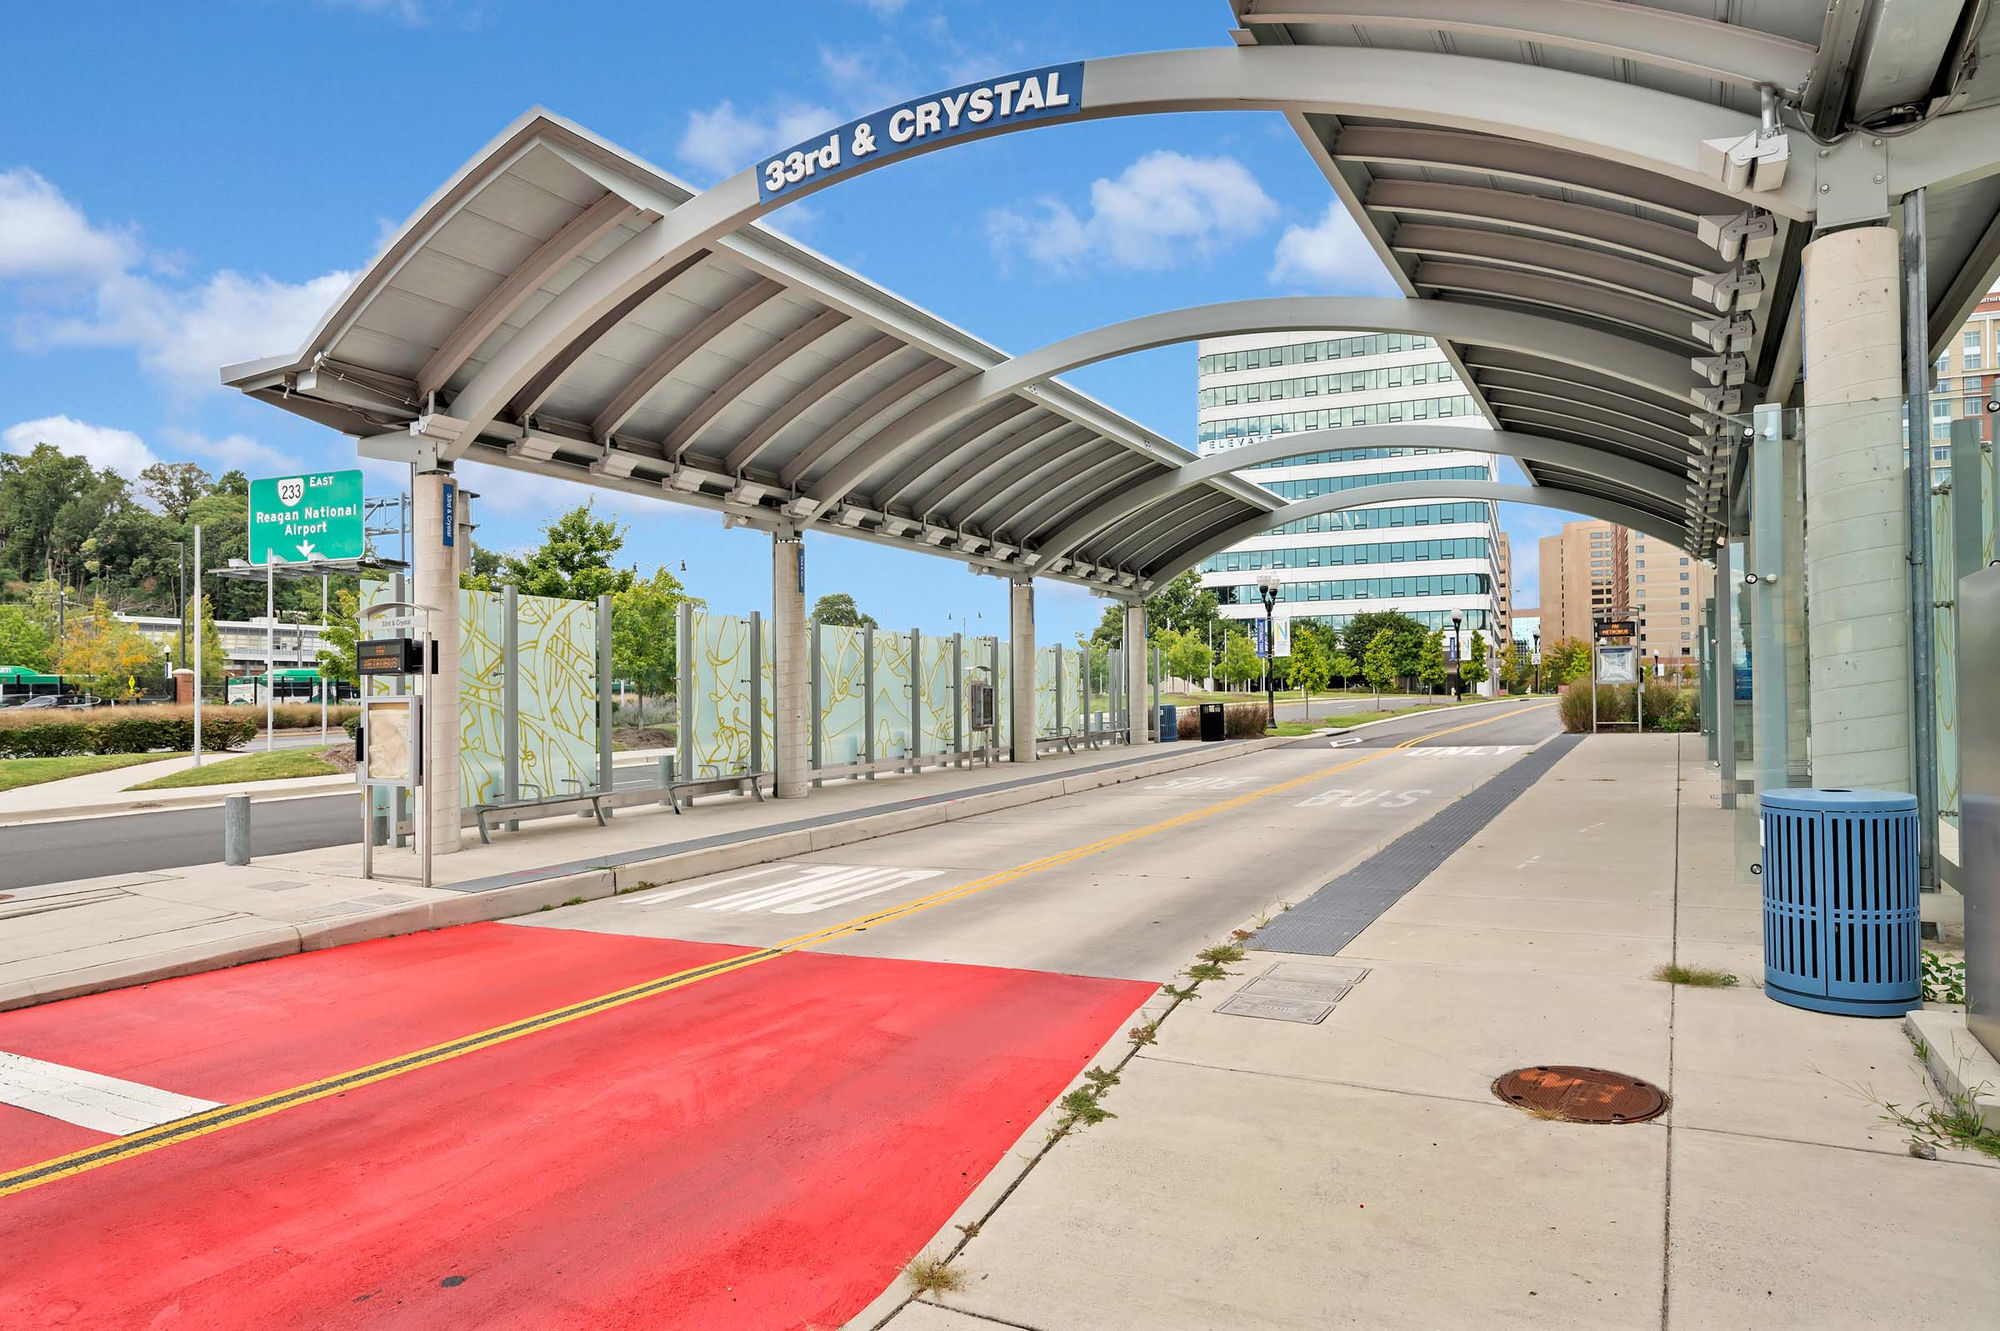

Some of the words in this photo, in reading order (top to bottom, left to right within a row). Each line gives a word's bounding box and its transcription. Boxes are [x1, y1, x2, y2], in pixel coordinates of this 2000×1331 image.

[765, 134, 841, 192] 33rd
[852, 123, 878, 157] &
[888, 72, 1070, 144] CRYSTAL
[281, 484, 301, 500] 233
[309, 476, 334, 487] EAST
[256, 511, 299, 525] Reagan
[304, 503, 357, 519] National
[284, 521, 327, 537] Airport
[1403, 745, 1520, 756] ONLY
[1293, 789, 1431, 807] BUS
